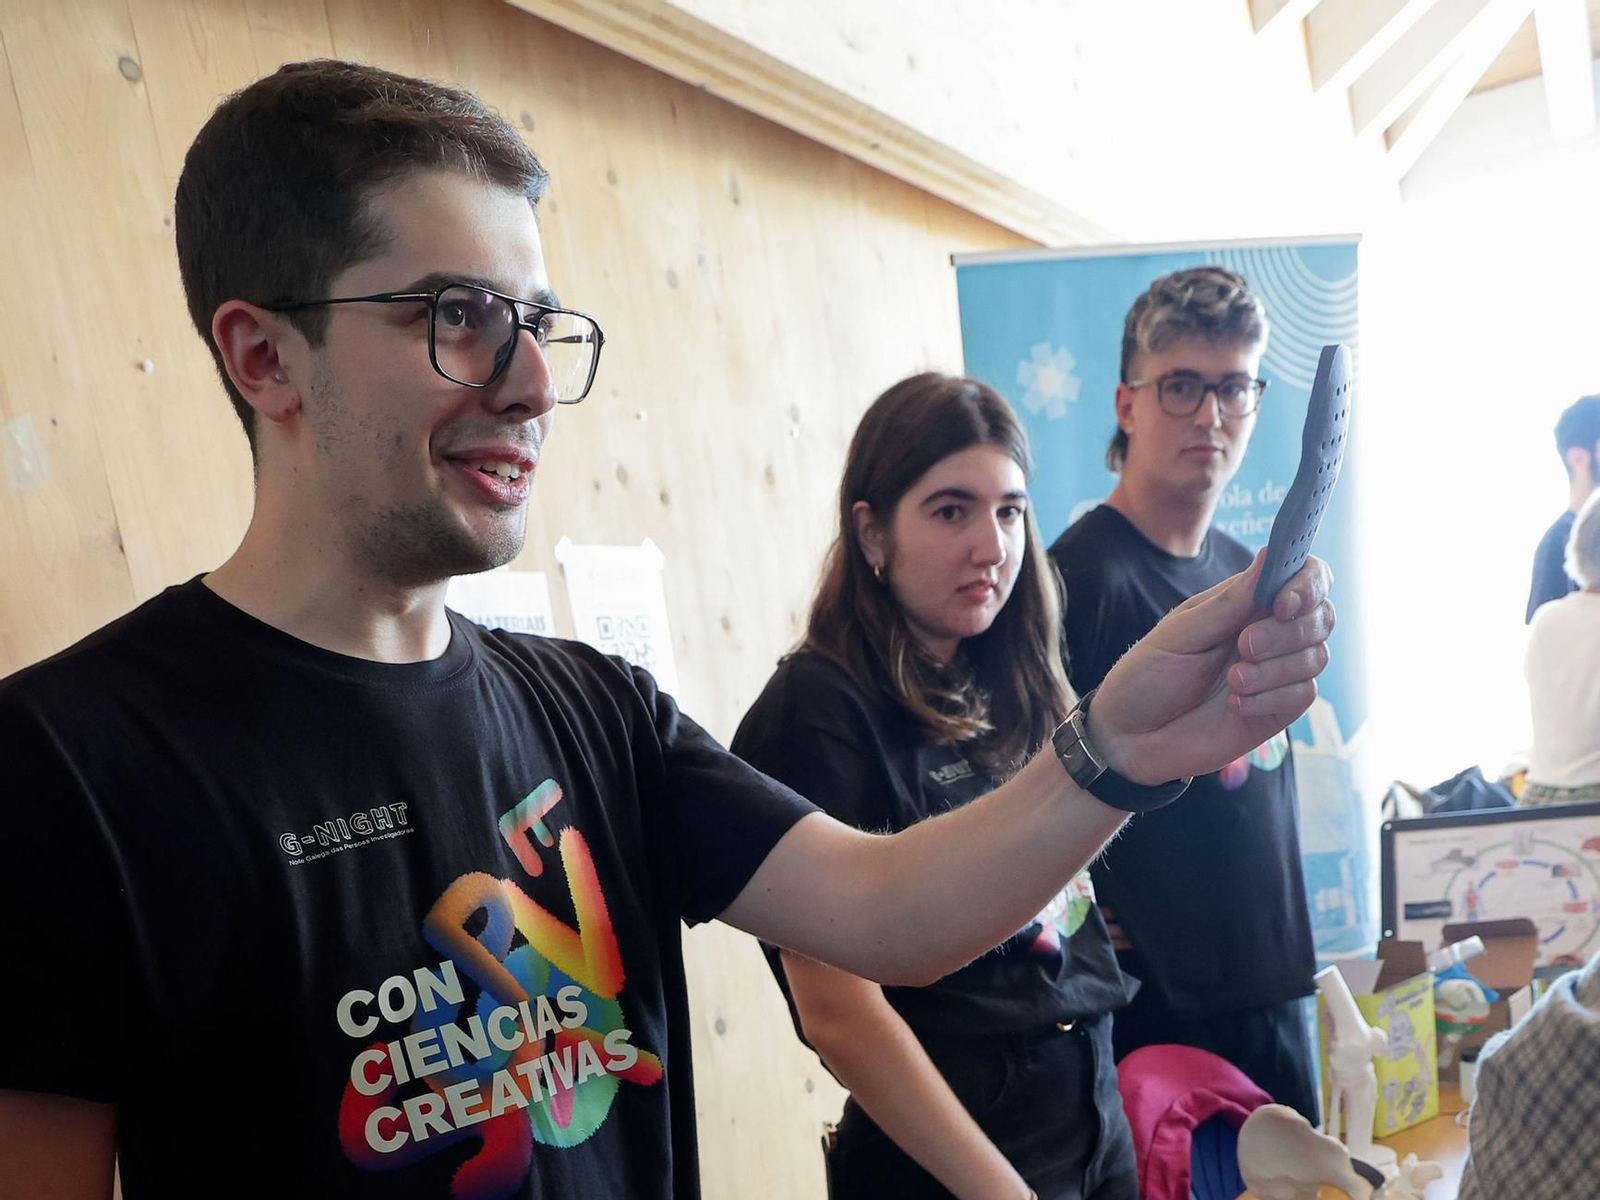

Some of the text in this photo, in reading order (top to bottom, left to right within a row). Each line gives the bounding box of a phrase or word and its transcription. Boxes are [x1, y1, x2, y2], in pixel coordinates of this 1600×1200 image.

[279, 801, 408, 856] G-NIGHT
[336, 960, 465, 1038] CON
[350, 985, 588, 1096] CIENCIAS
[364, 1029, 639, 1153] CREATIVAS
